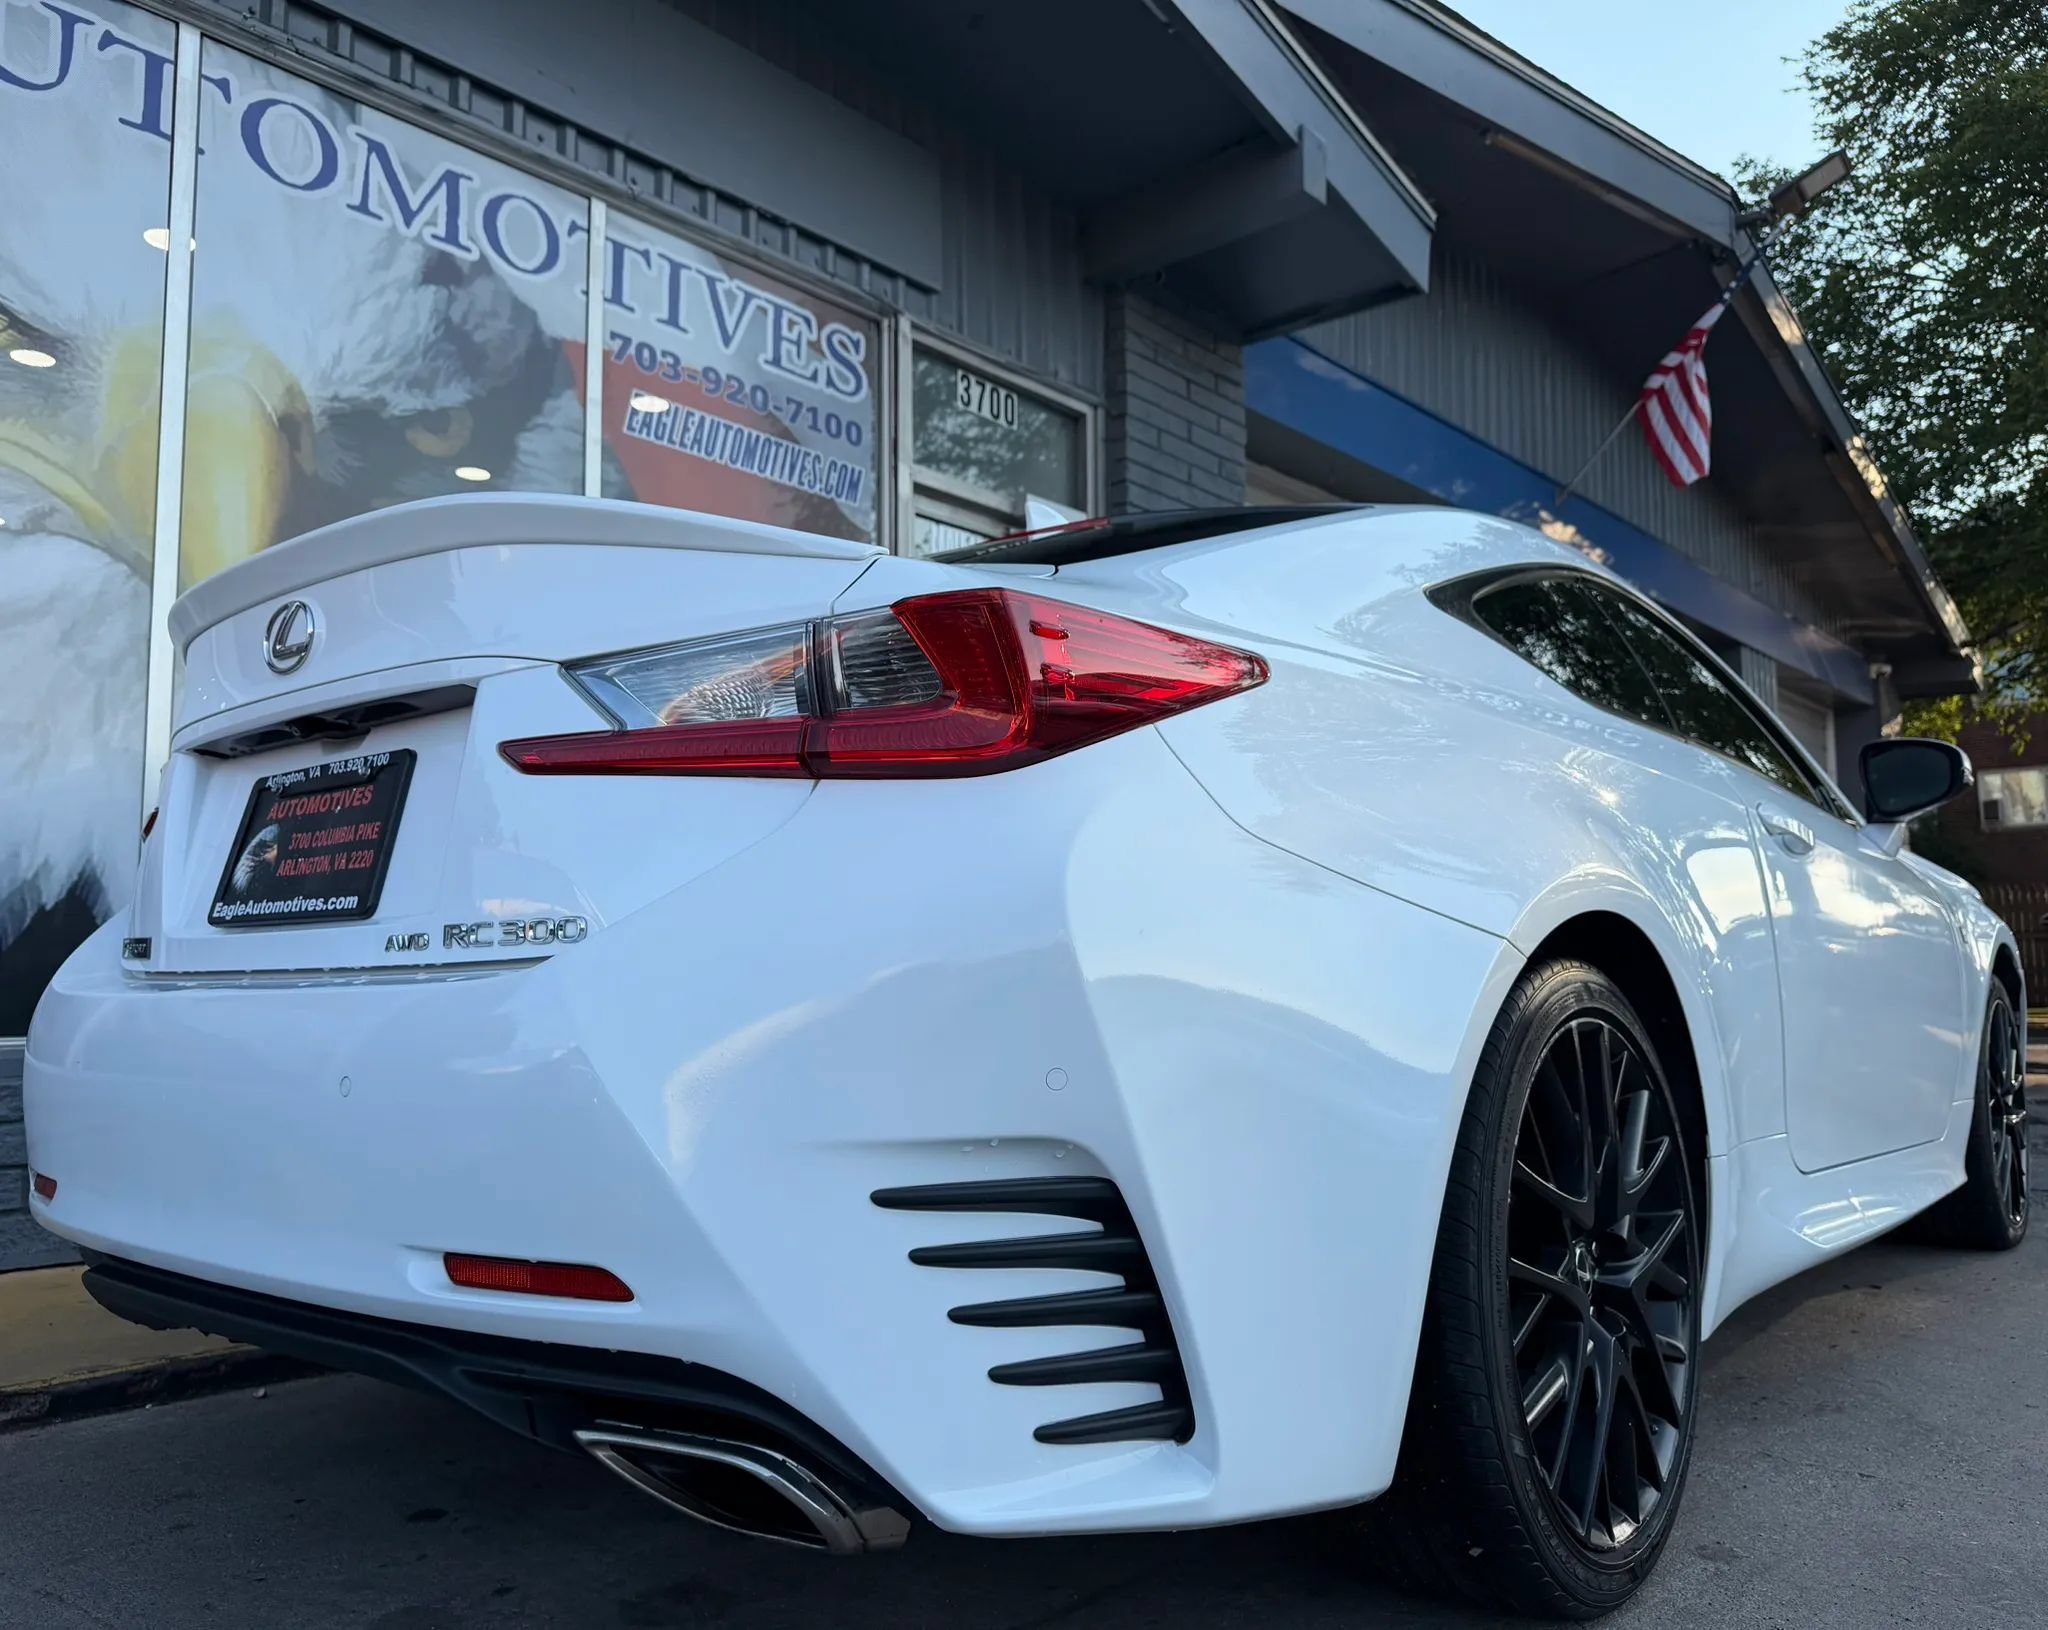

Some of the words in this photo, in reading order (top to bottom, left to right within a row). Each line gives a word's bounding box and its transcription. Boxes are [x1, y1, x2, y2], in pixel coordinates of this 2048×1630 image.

[609, 331, 863, 446] 703-920-7100
[960, 373, 1015, 426] 3700
[626, 392, 864, 503] EAGLEAUTOMOTIVES.COM
[309, 766, 321, 779] VA
[267, 785, 375, 821] AUTOMOTIVES
[312, 824, 356, 847] COLUMBIA
[356, 822, 382, 840] PIKE
[334, 851, 347, 870] VA
[348, 849, 375, 869] 2220
[212, 895, 359, 920] EagleAutomotives.com
[384, 933, 430, 952] AWD
